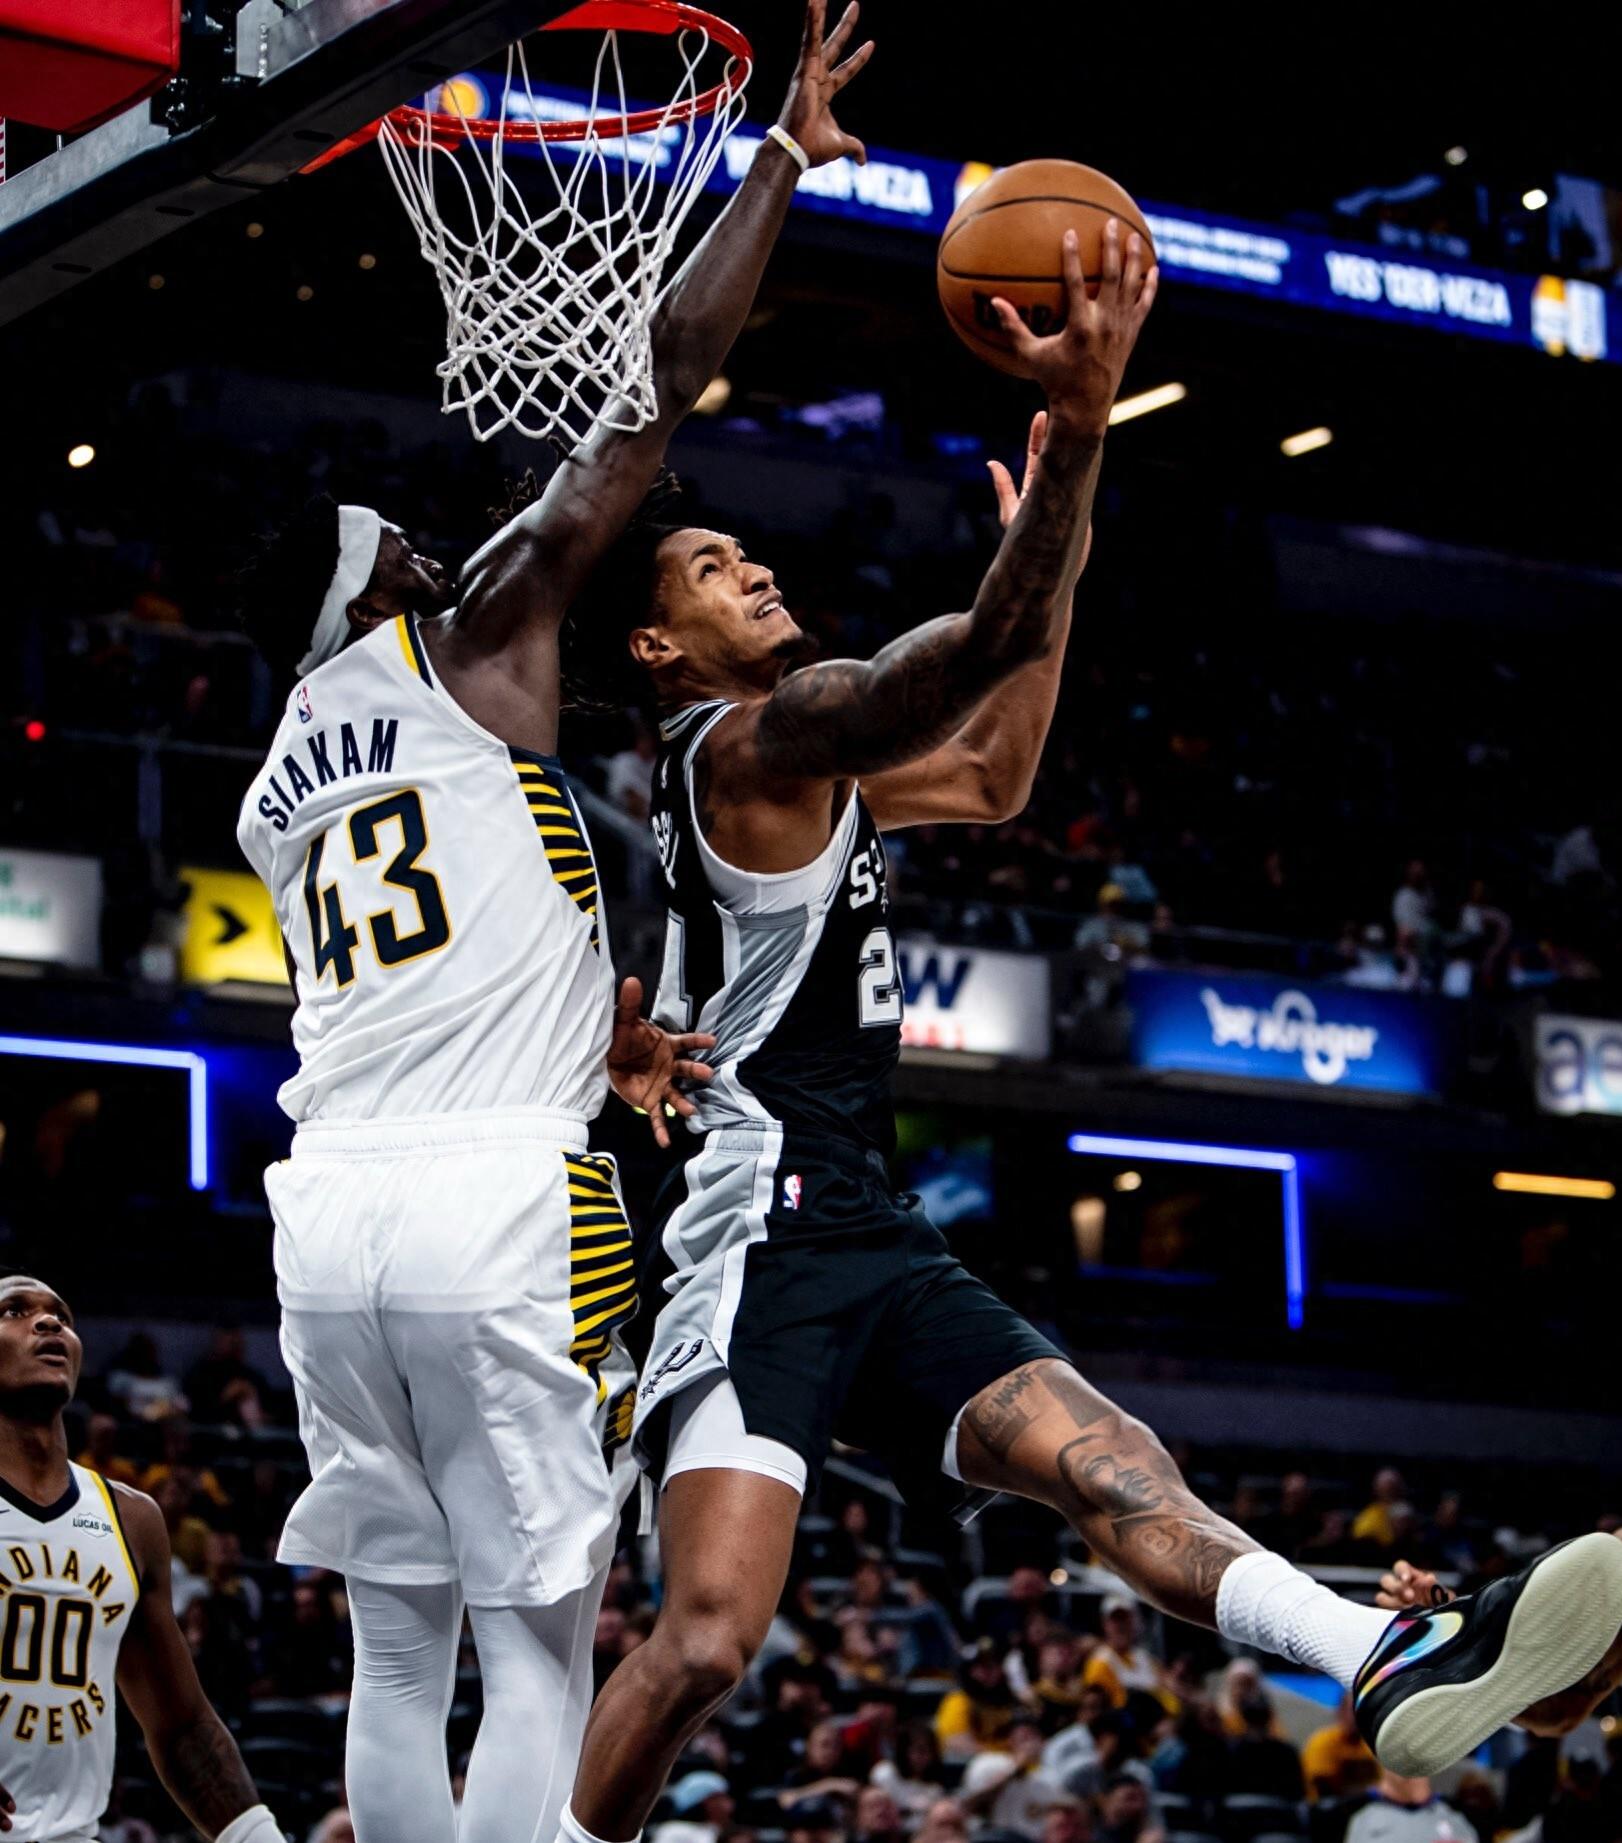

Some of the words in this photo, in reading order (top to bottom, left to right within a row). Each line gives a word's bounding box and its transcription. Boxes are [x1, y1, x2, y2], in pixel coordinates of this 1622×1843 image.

[258, 718, 399, 833] SIAKAM
[304, 785, 453, 991] 43
[73, 1517, 100, 1530] LUCAS
[0, 1592, 94, 1690] 00
